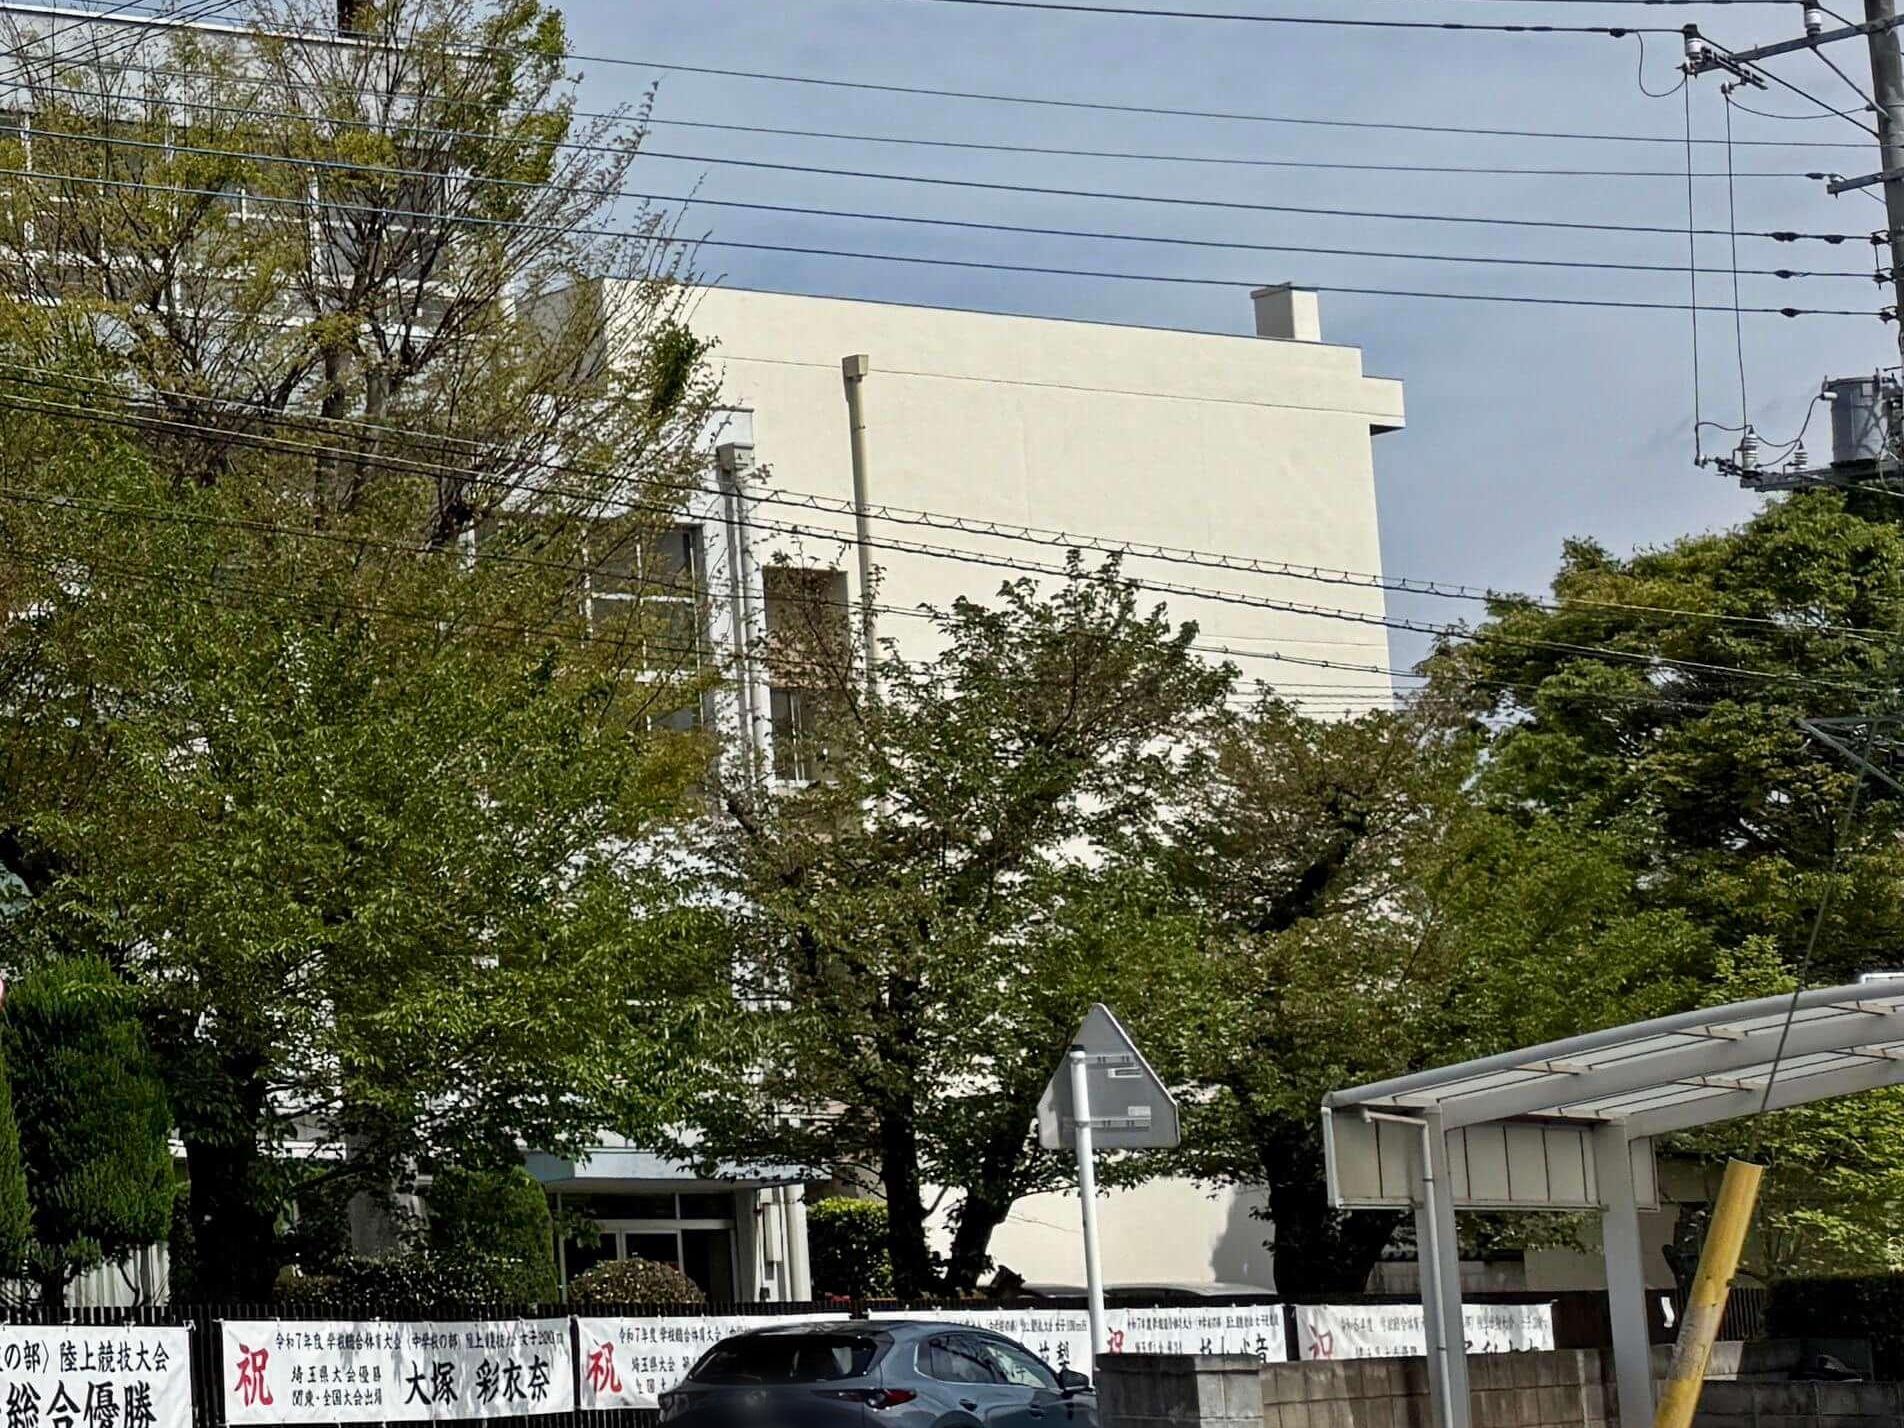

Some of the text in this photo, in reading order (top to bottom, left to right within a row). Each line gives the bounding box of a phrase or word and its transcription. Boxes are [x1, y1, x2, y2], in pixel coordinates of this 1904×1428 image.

[60, 1339, 170, 1374] 陸上競技大会
[234, 1342, 274, 1407] 祝
[405, 1354, 551, 1405] 大塚 彩衣奈
